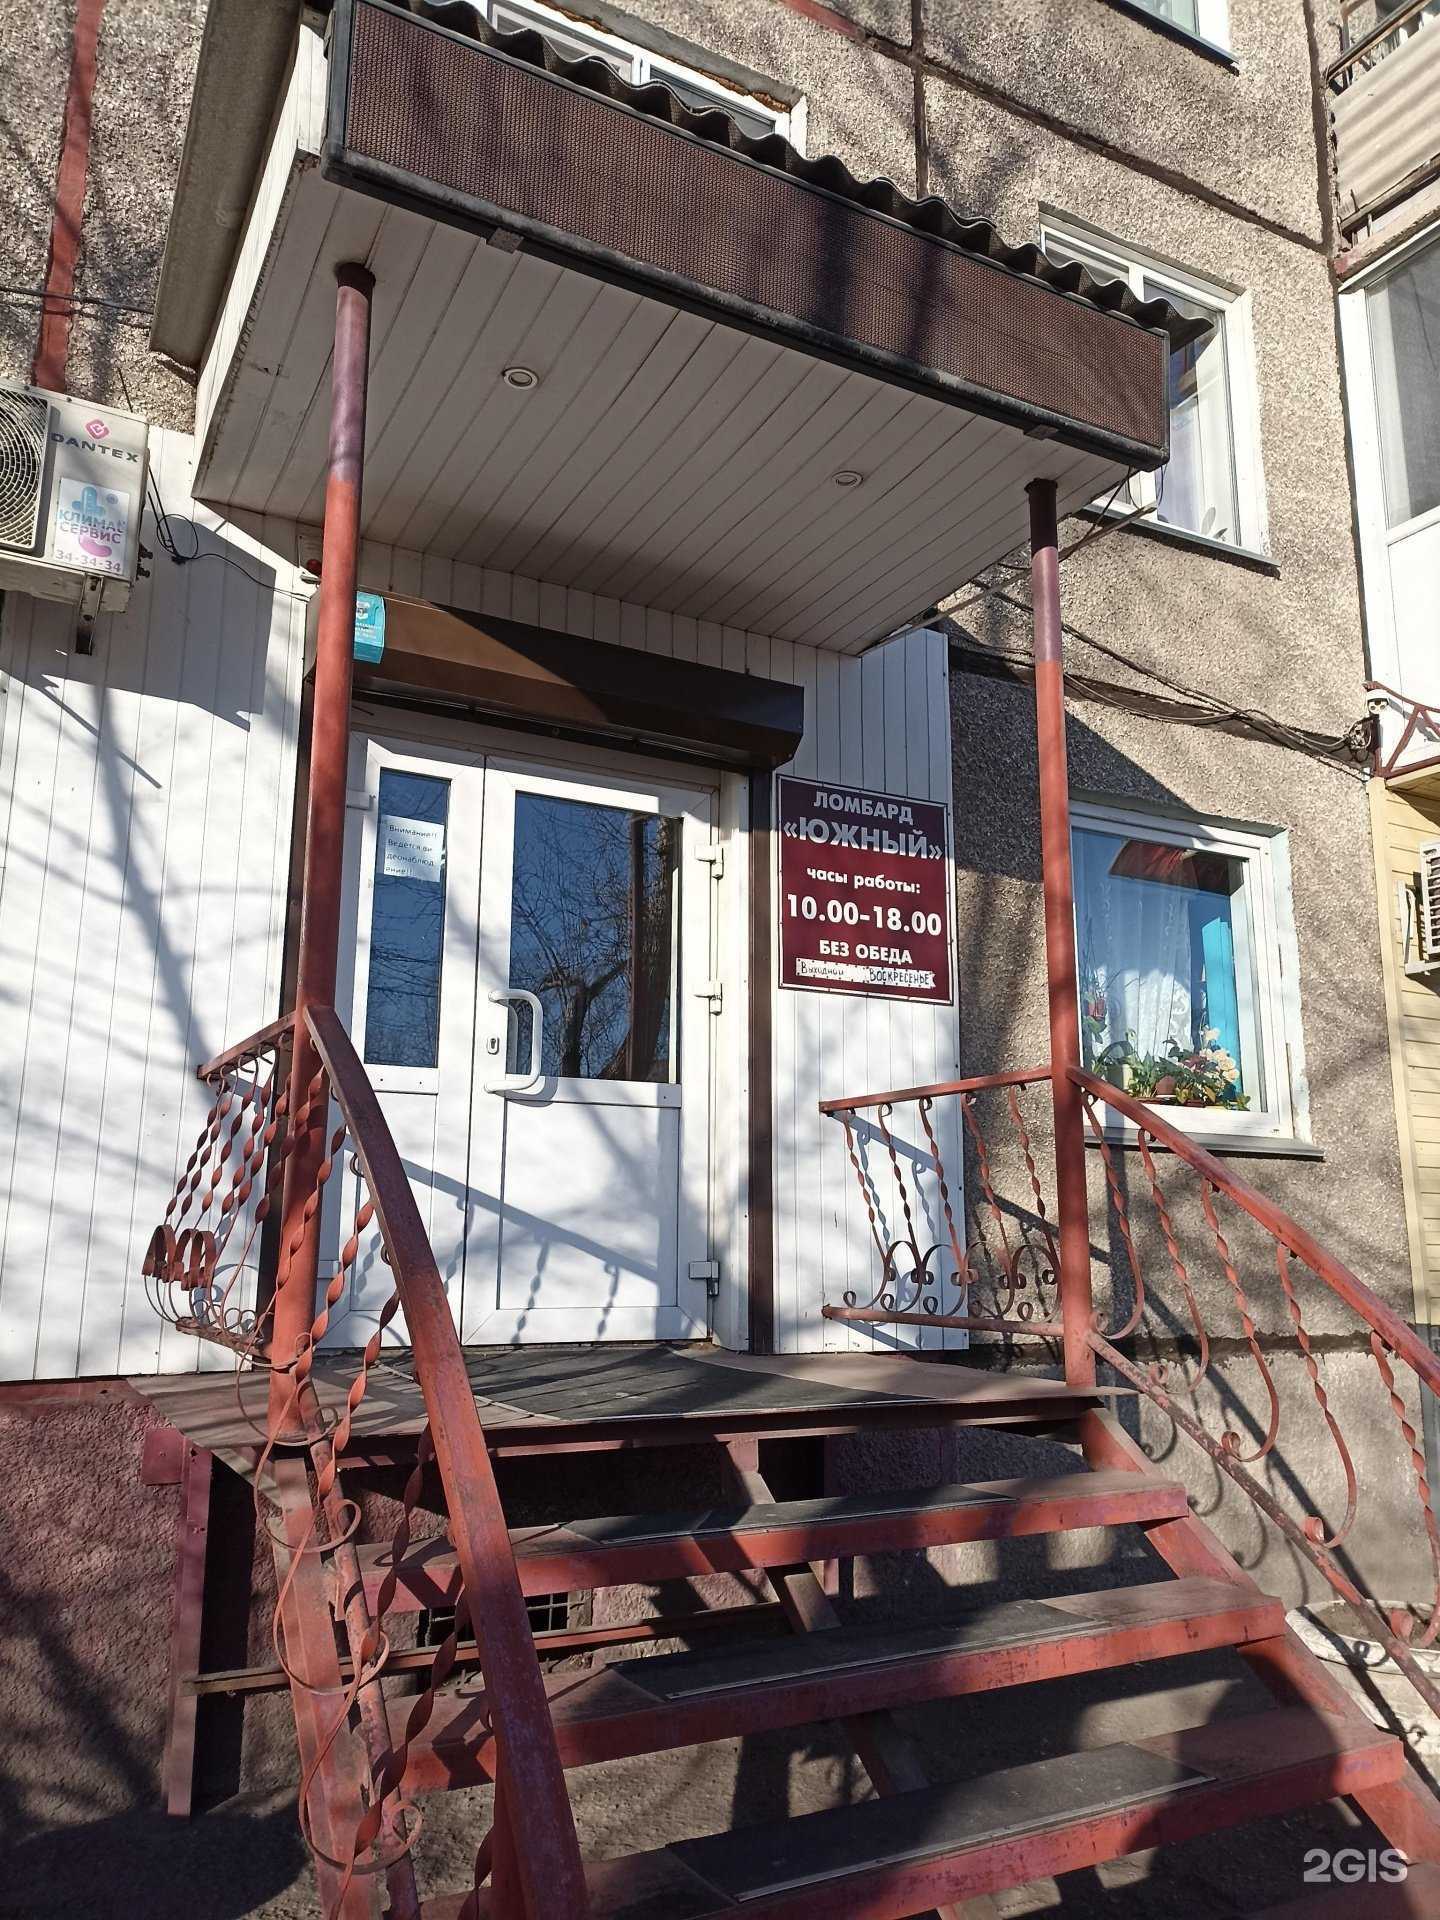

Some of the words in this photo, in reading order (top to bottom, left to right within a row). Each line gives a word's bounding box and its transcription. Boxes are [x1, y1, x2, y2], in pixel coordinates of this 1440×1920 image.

[51, 432, 138, 463] DANTEX
[60, 521, 121, 544] СЕРВИС
[55, 549, 122, 572] 34-34-34
[813, 791, 914, 825] ЛОМБАРД
[783, 816, 943, 860] «ЮЖНЫЙ»
[806, 867, 848, 884] часы
[854, 874, 921, 894] работы:
[787, 893, 942, 936] 10.00-18.00
[819, 939, 850, 957] БЕЗ
[855, 944, 913, 965] ОБЕДА
[869, 968, 930, 985] ВОСКРЕСЕНЬЕ
